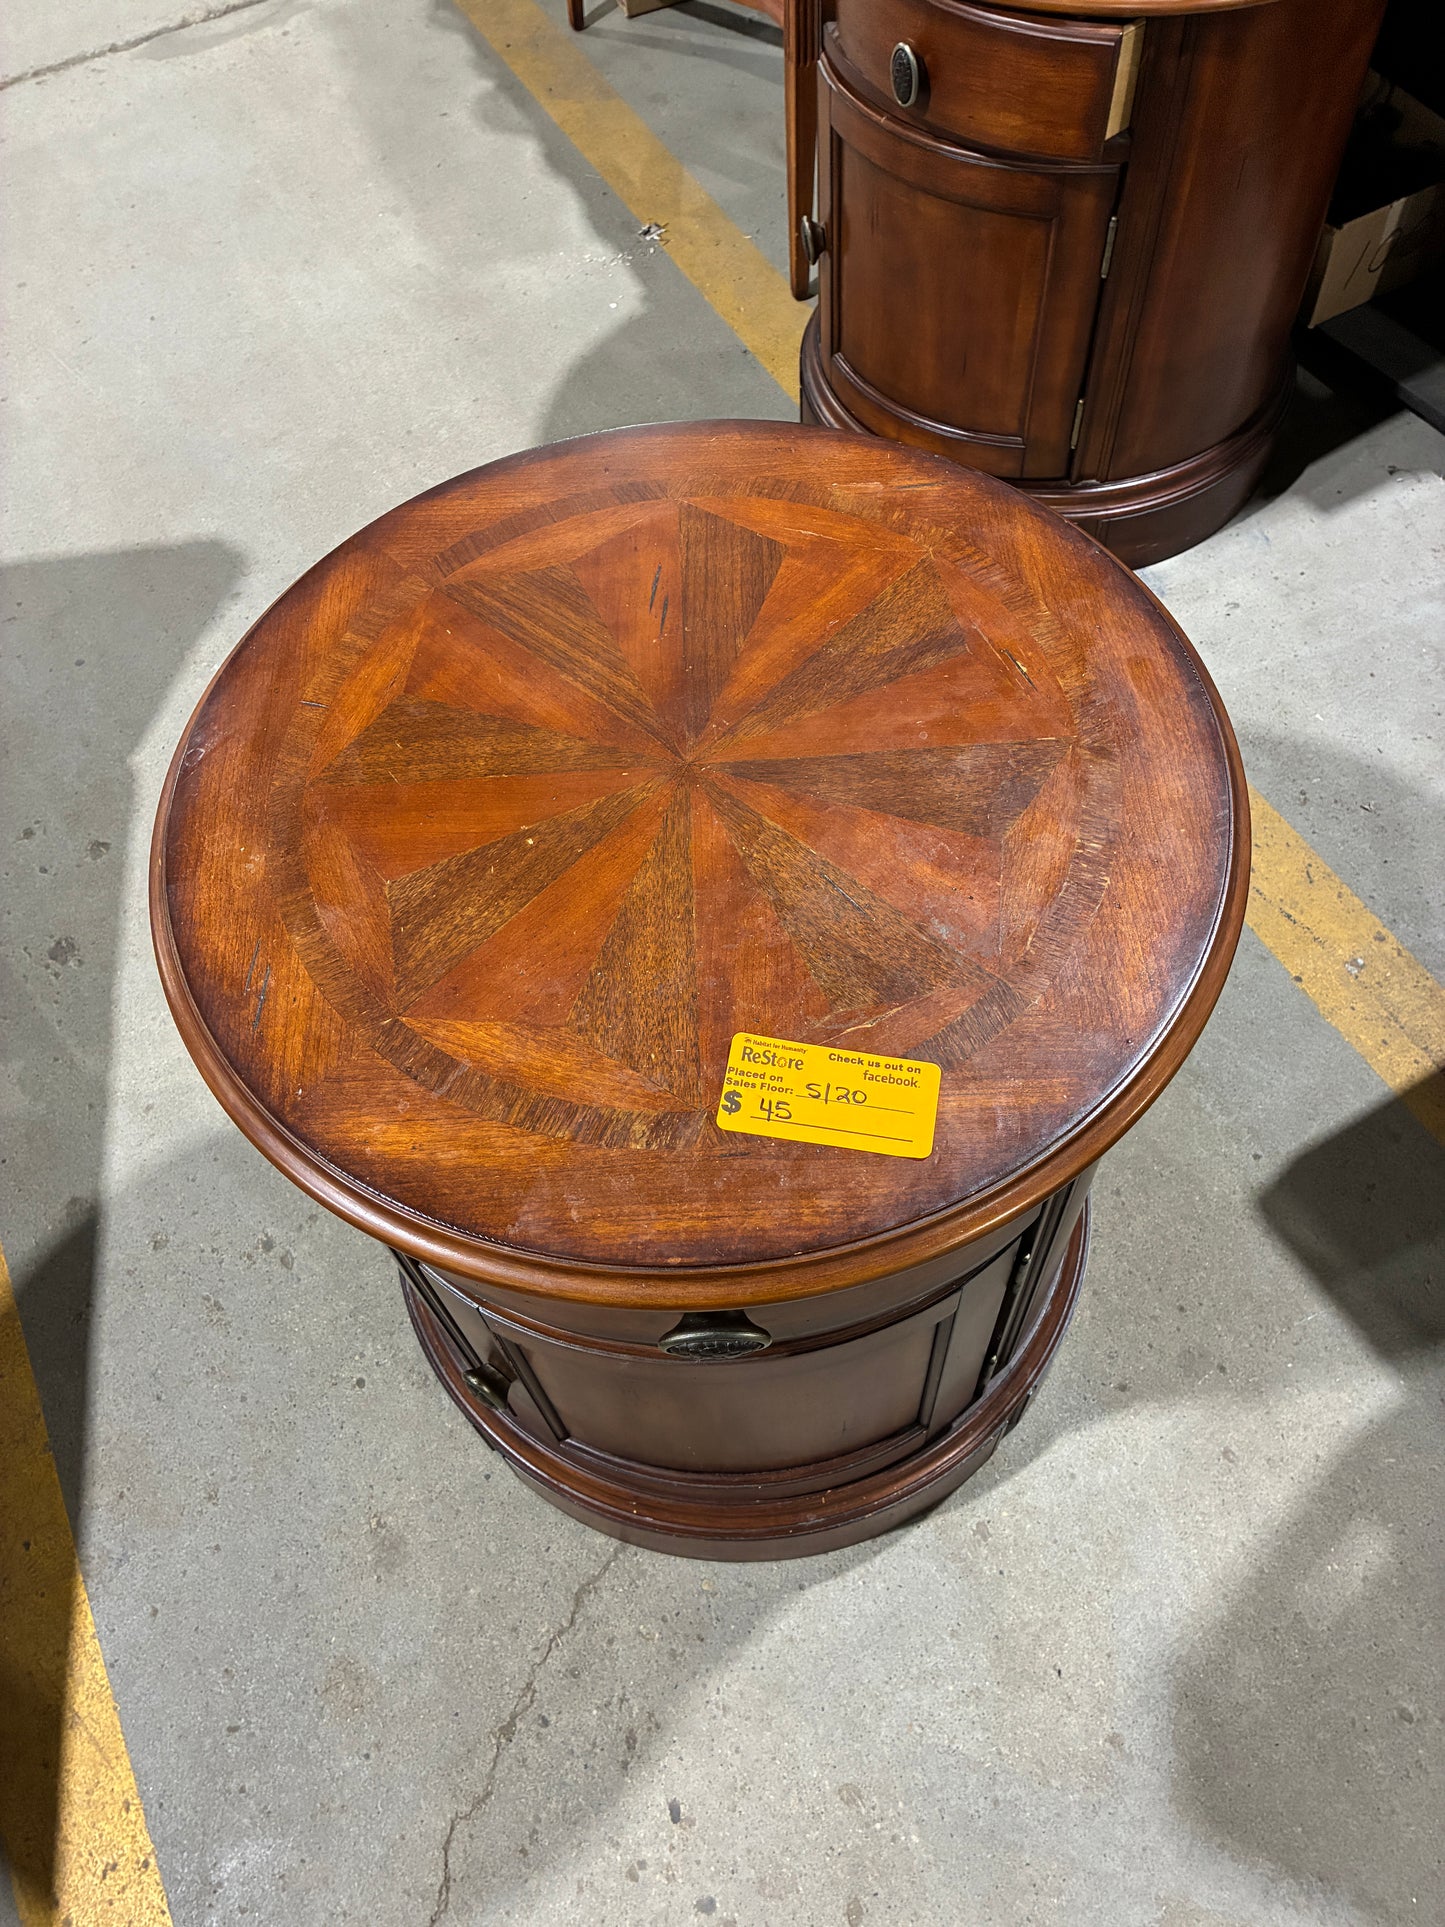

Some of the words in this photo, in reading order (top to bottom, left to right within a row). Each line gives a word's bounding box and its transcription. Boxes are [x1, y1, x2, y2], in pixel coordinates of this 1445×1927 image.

[752, 1039, 772, 1049] Habitat
[781, 1044, 808, 1055] Humanity
[741, 1046, 804, 1070] ReStore
[828, 1053, 864, 1066] Check
[867, 1060, 880, 1068] us
[884, 1063, 904, 1071] out
[906, 1066, 921, 1074] on
[727, 1066, 766, 1080] Placed
[769, 1075, 783, 1083] on
[725, 1077, 757, 1089] Sales
[760, 1082, 793, 1095] Floor:
[721, 1090, 742, 1115] $
[760, 1098, 792, 1121] 45
